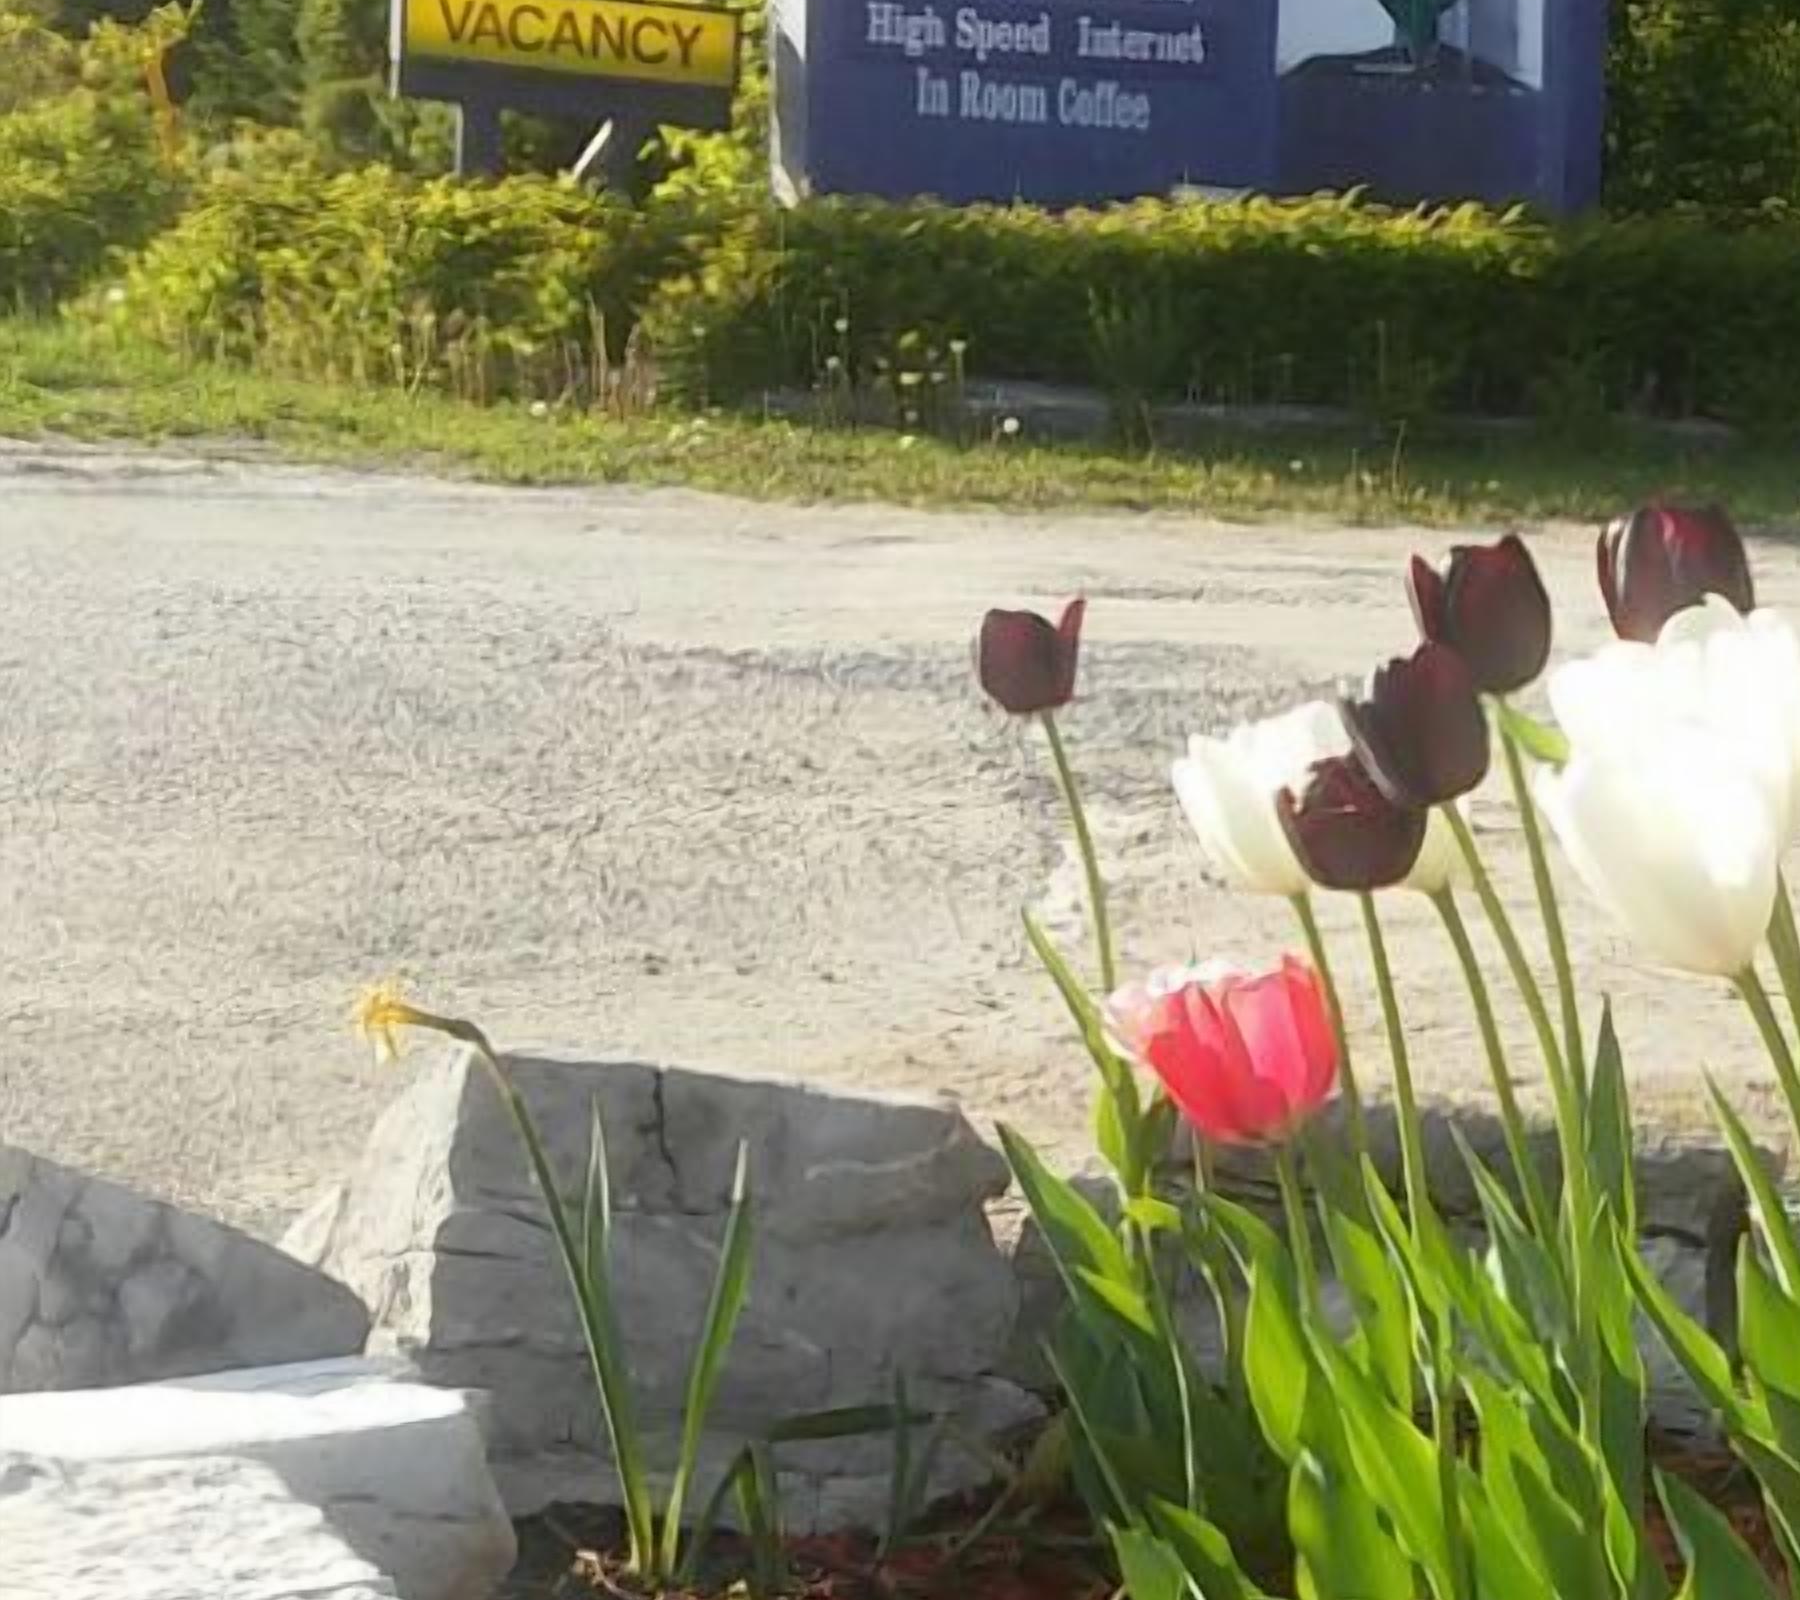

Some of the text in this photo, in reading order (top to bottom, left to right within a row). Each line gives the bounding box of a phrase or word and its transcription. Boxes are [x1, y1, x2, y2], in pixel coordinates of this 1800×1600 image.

[866, 1, 1204, 63] High Speed Internet
[917, 67, 1150, 130] In Room Coffee
